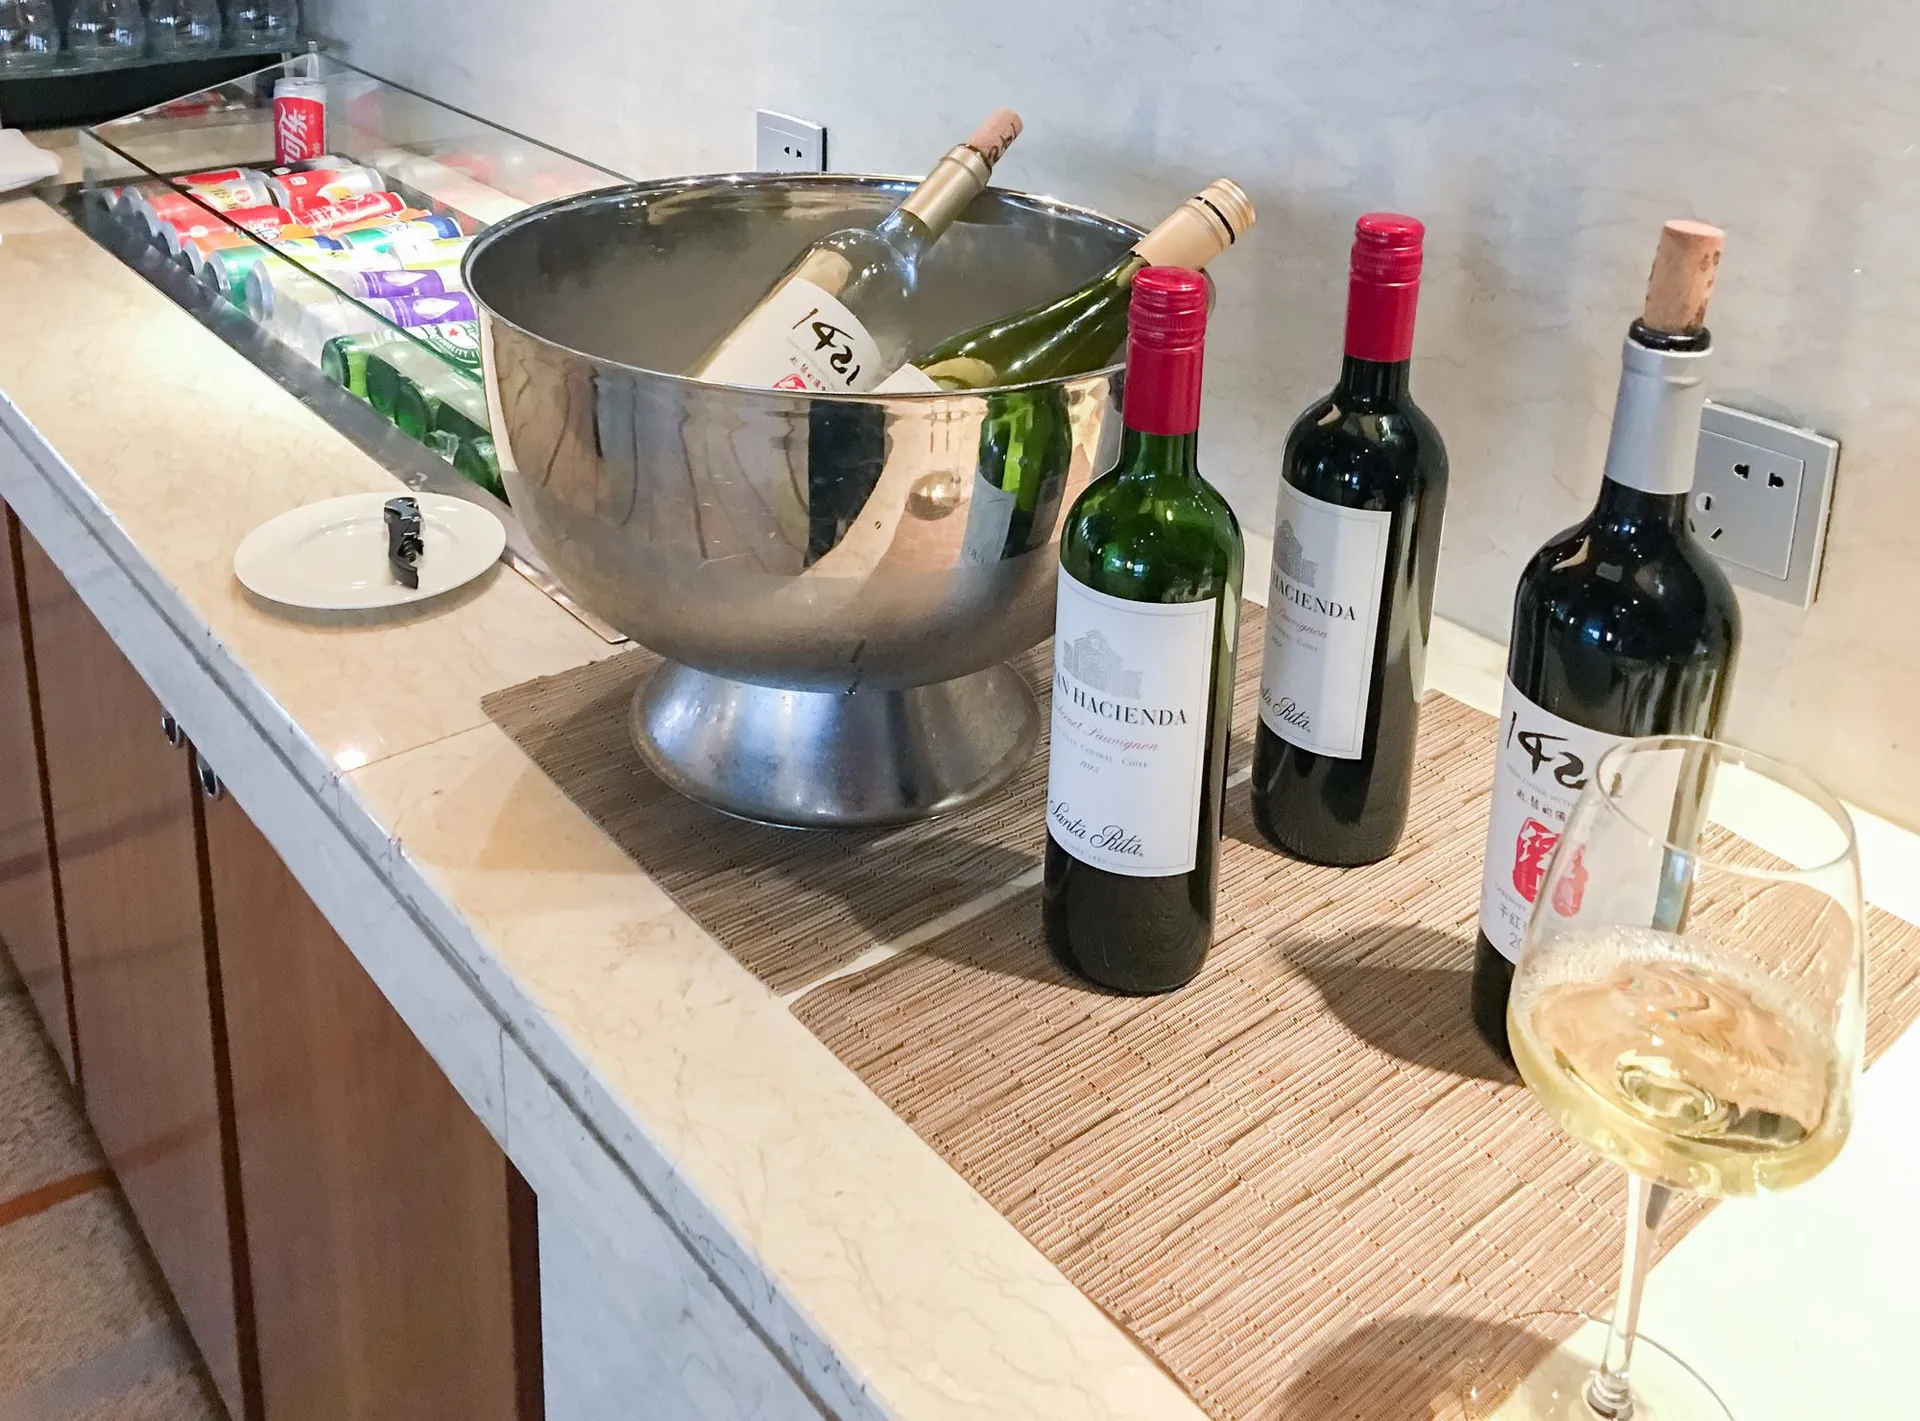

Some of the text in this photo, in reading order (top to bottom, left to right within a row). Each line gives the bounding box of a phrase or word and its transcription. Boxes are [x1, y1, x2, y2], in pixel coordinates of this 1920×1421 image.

[1073, 687, 1187, 726] HACIENDA
[1272, 697, 1310, 731] Rita
[1086, 727, 1159, 752] Sauvignon
[1050, 799, 1086, 840] Santa
[1090, 824, 1142, 856] Rita
